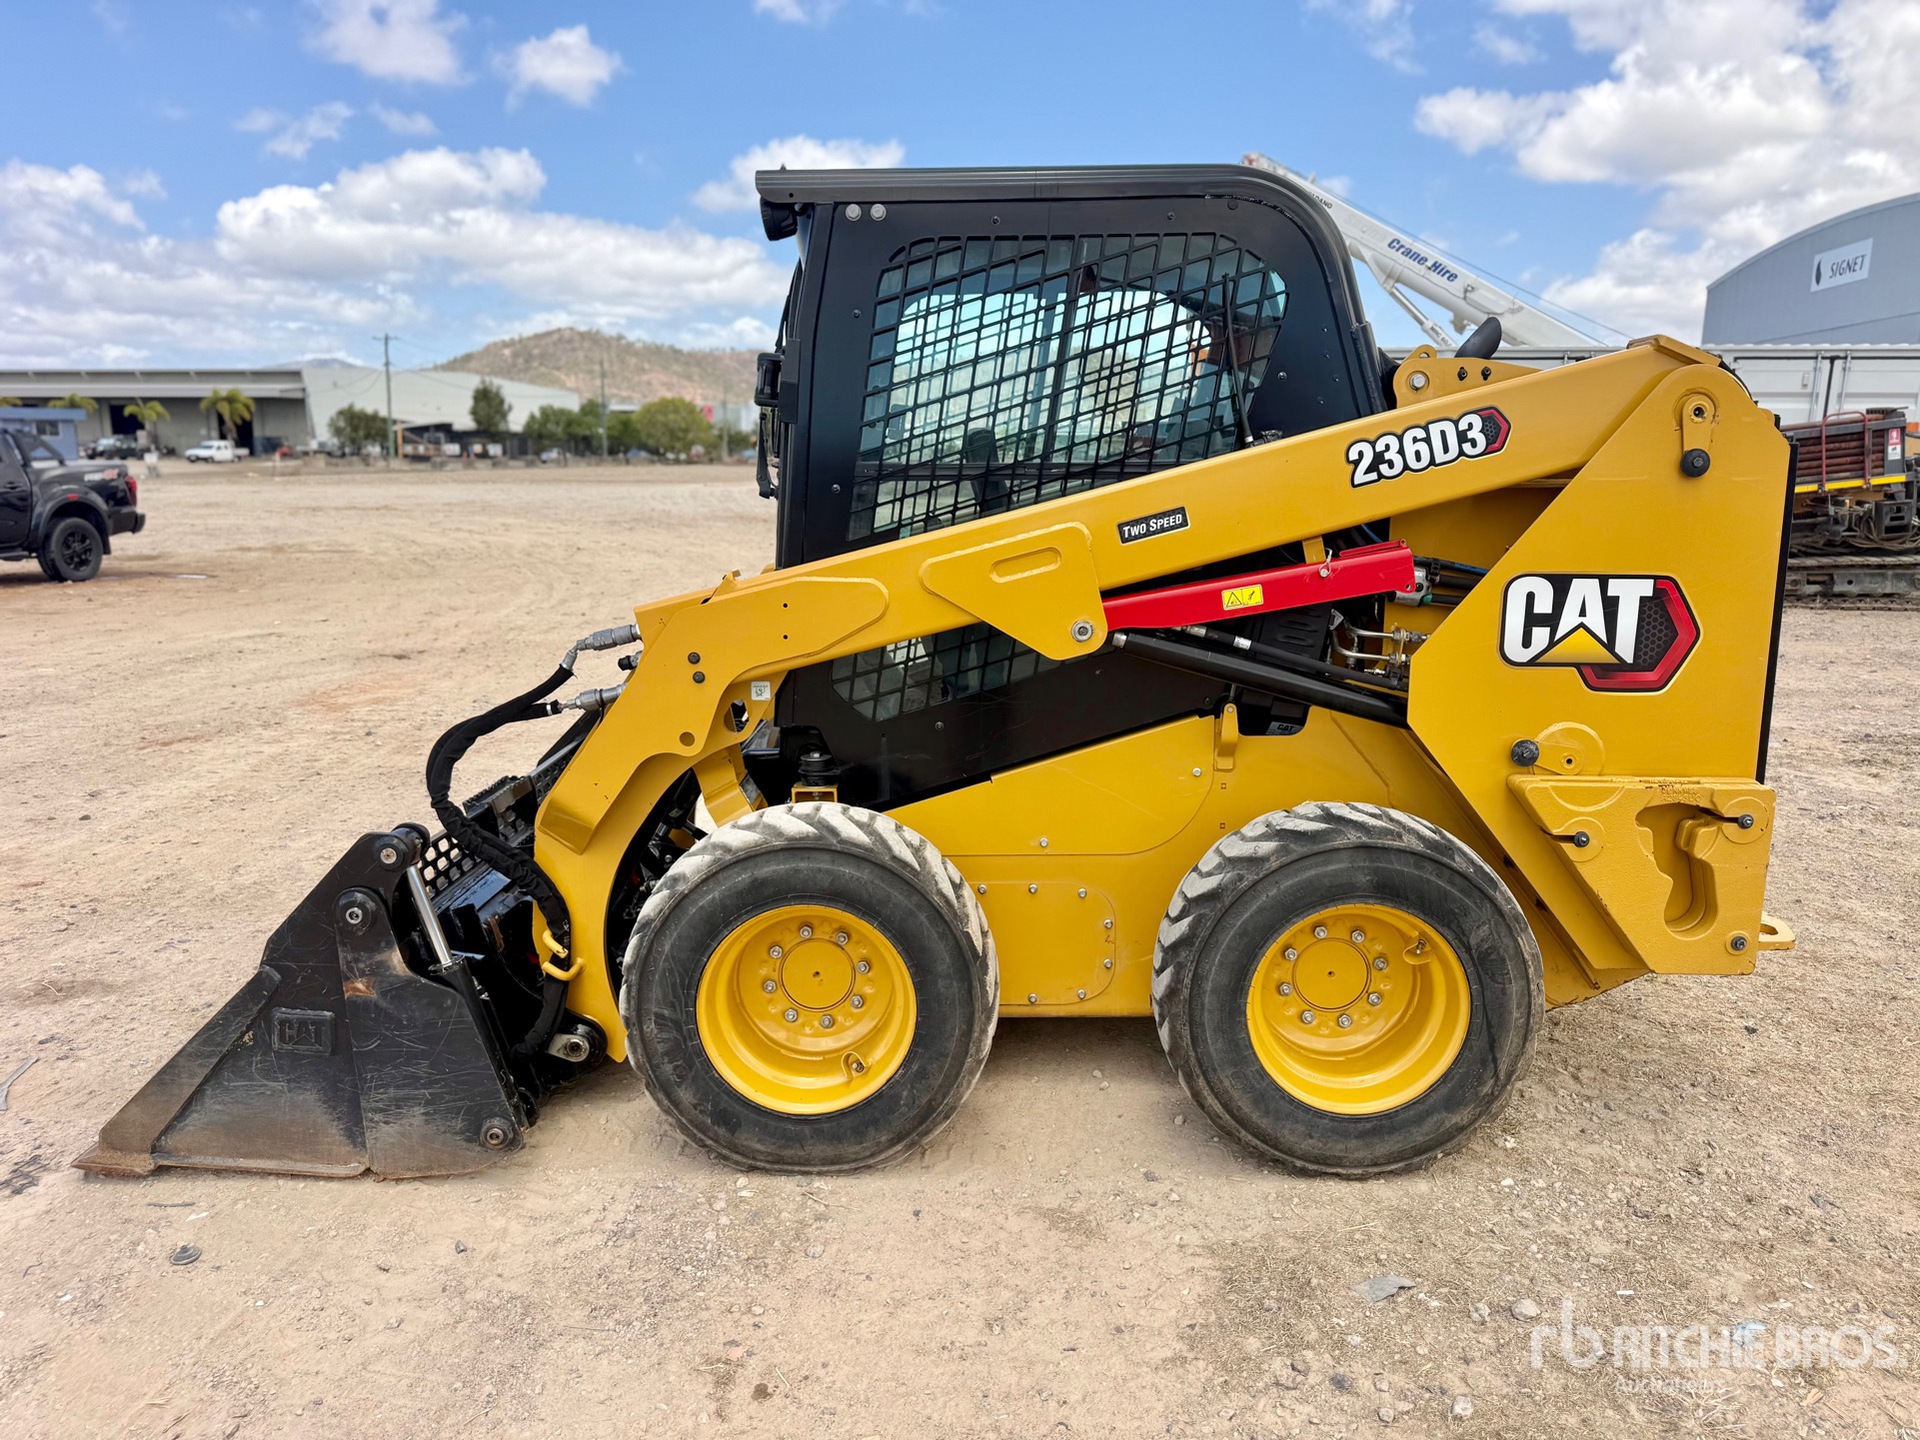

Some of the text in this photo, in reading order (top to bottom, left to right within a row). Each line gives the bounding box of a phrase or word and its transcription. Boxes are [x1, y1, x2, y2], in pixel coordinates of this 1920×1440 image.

[1387, 238, 1458, 282] Crane Hire
[1829, 254, 1867, 279] SIGNET
[1348, 413, 1487, 485] 236D3
[1503, 576, 1654, 664] CAT
[1277, 723, 1295, 732] CAT
